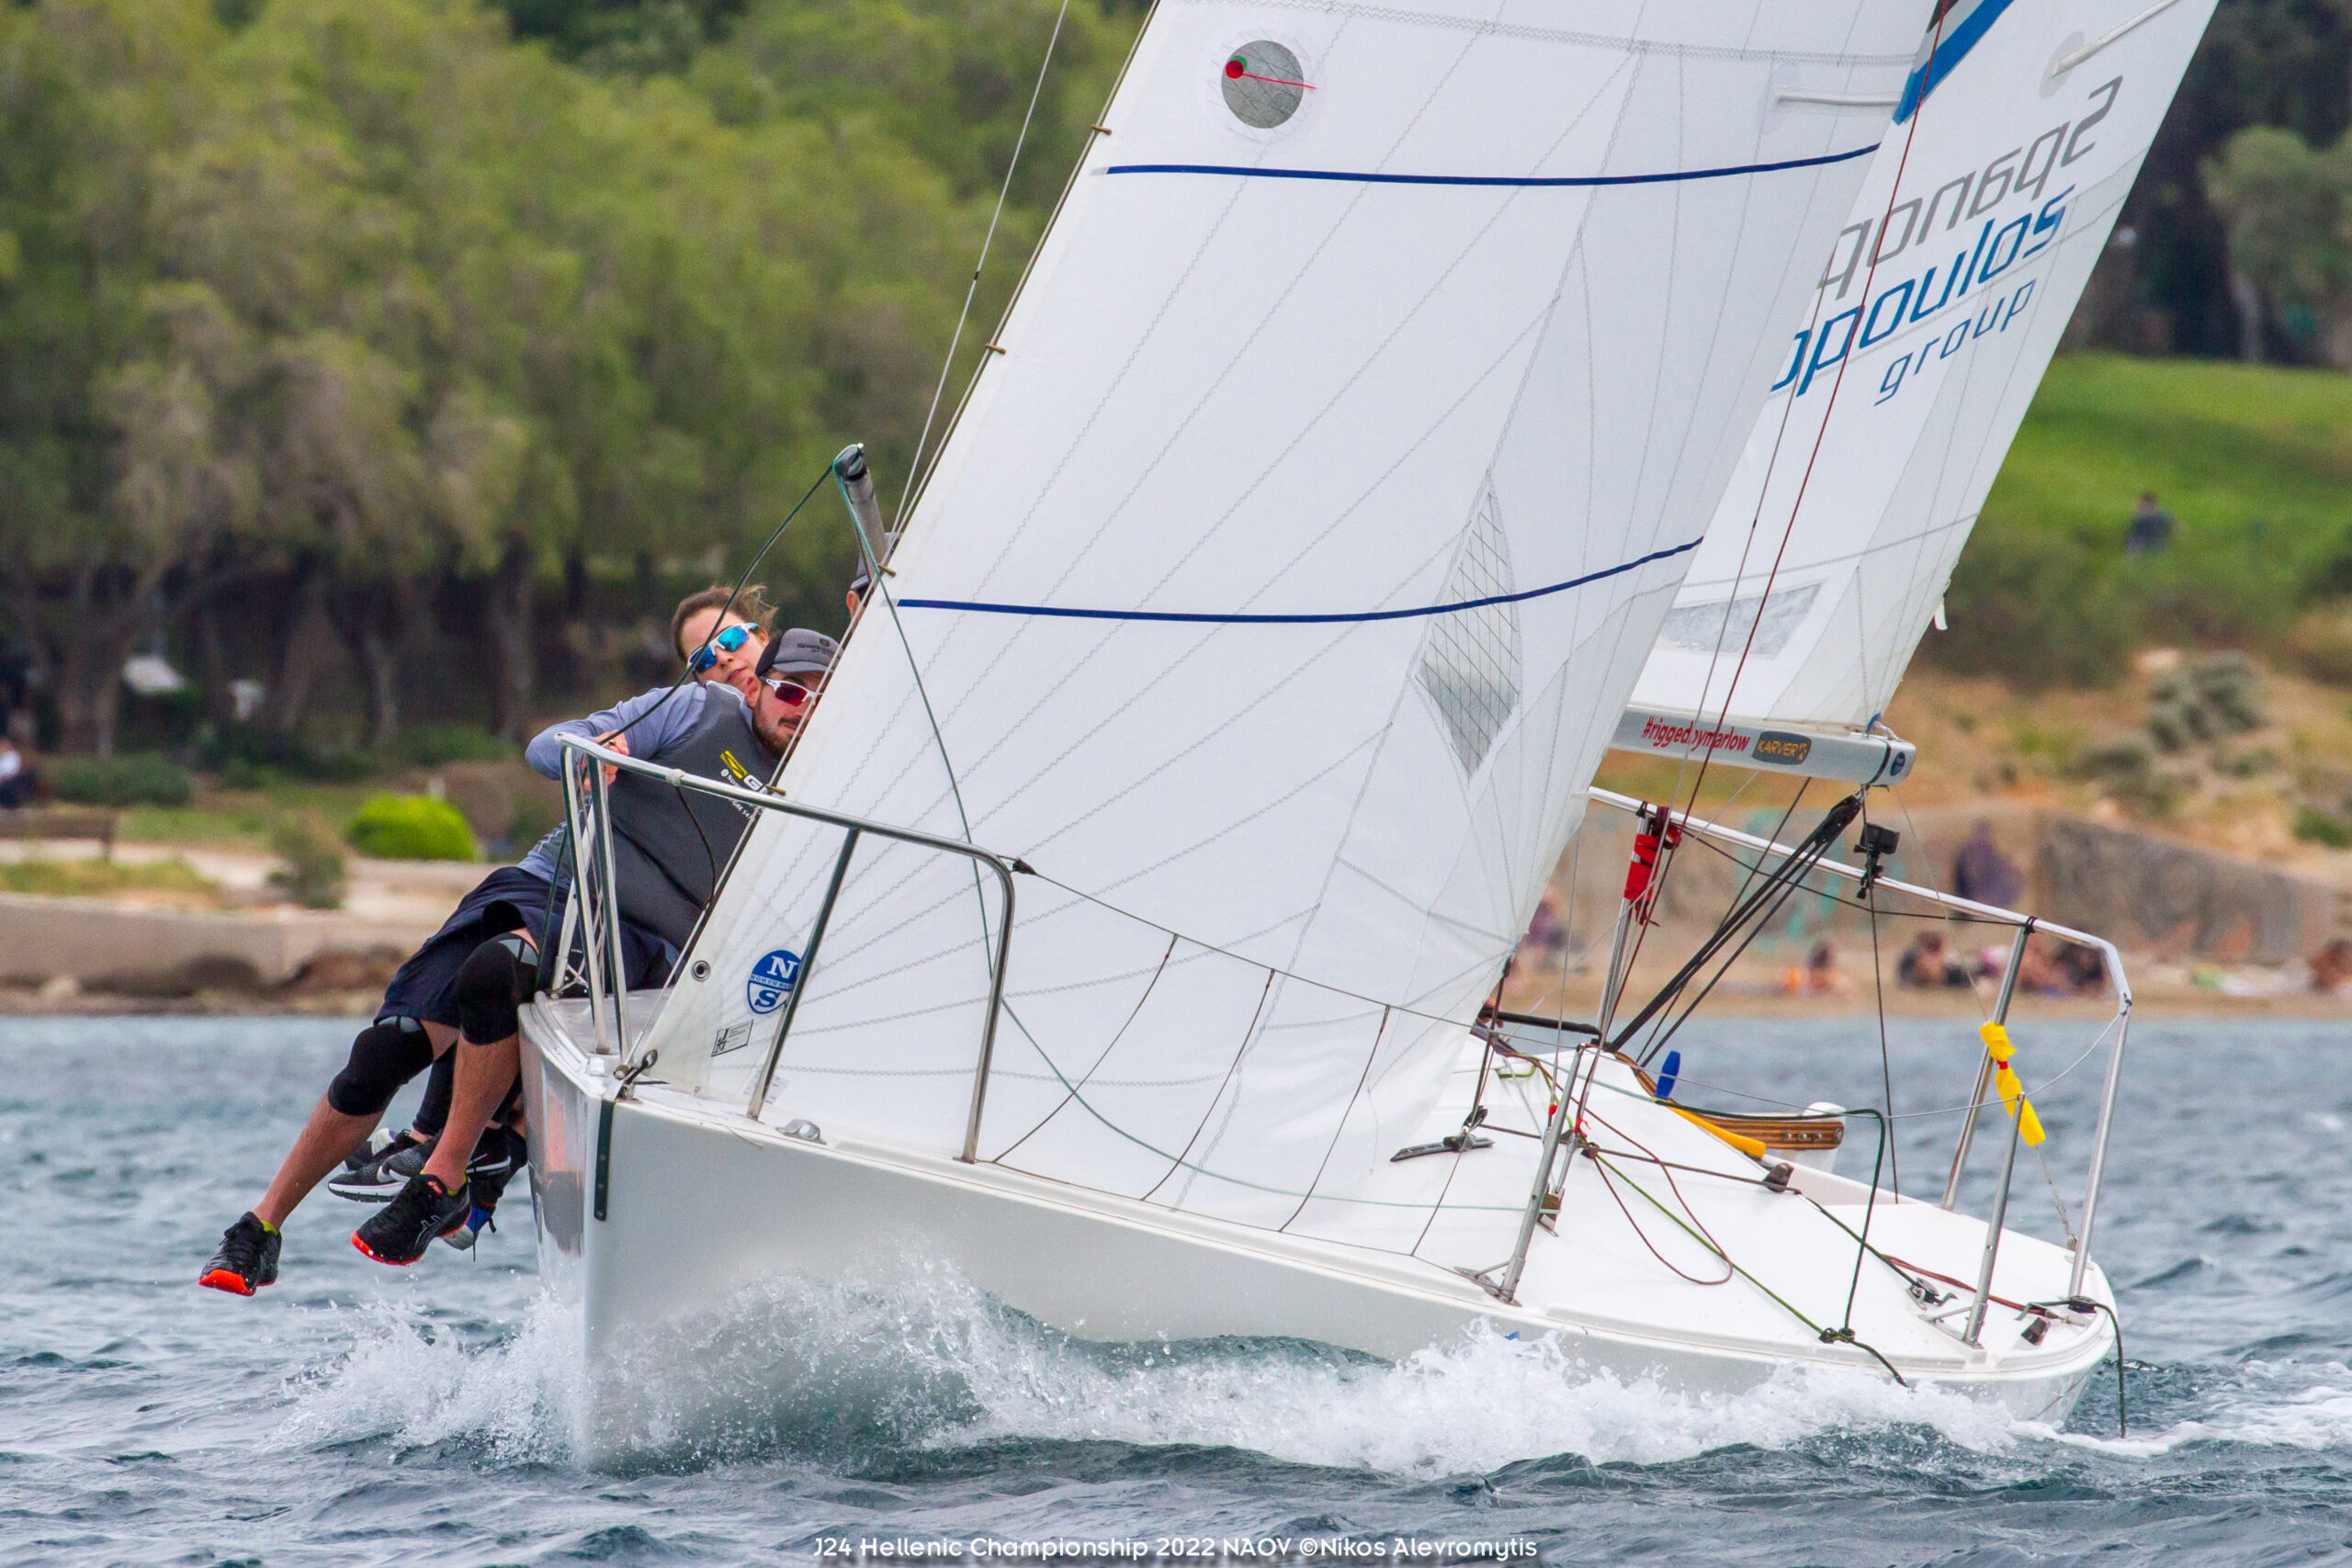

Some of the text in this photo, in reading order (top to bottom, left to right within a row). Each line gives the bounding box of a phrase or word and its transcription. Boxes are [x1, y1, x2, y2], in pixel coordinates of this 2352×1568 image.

[1873, 277, 2037, 407] group
[1757, 739, 1798, 758] KARVER
[766, 955, 798, 979] N
[750, 975, 778, 987] NORTH
[754, 989, 781, 1008] S
